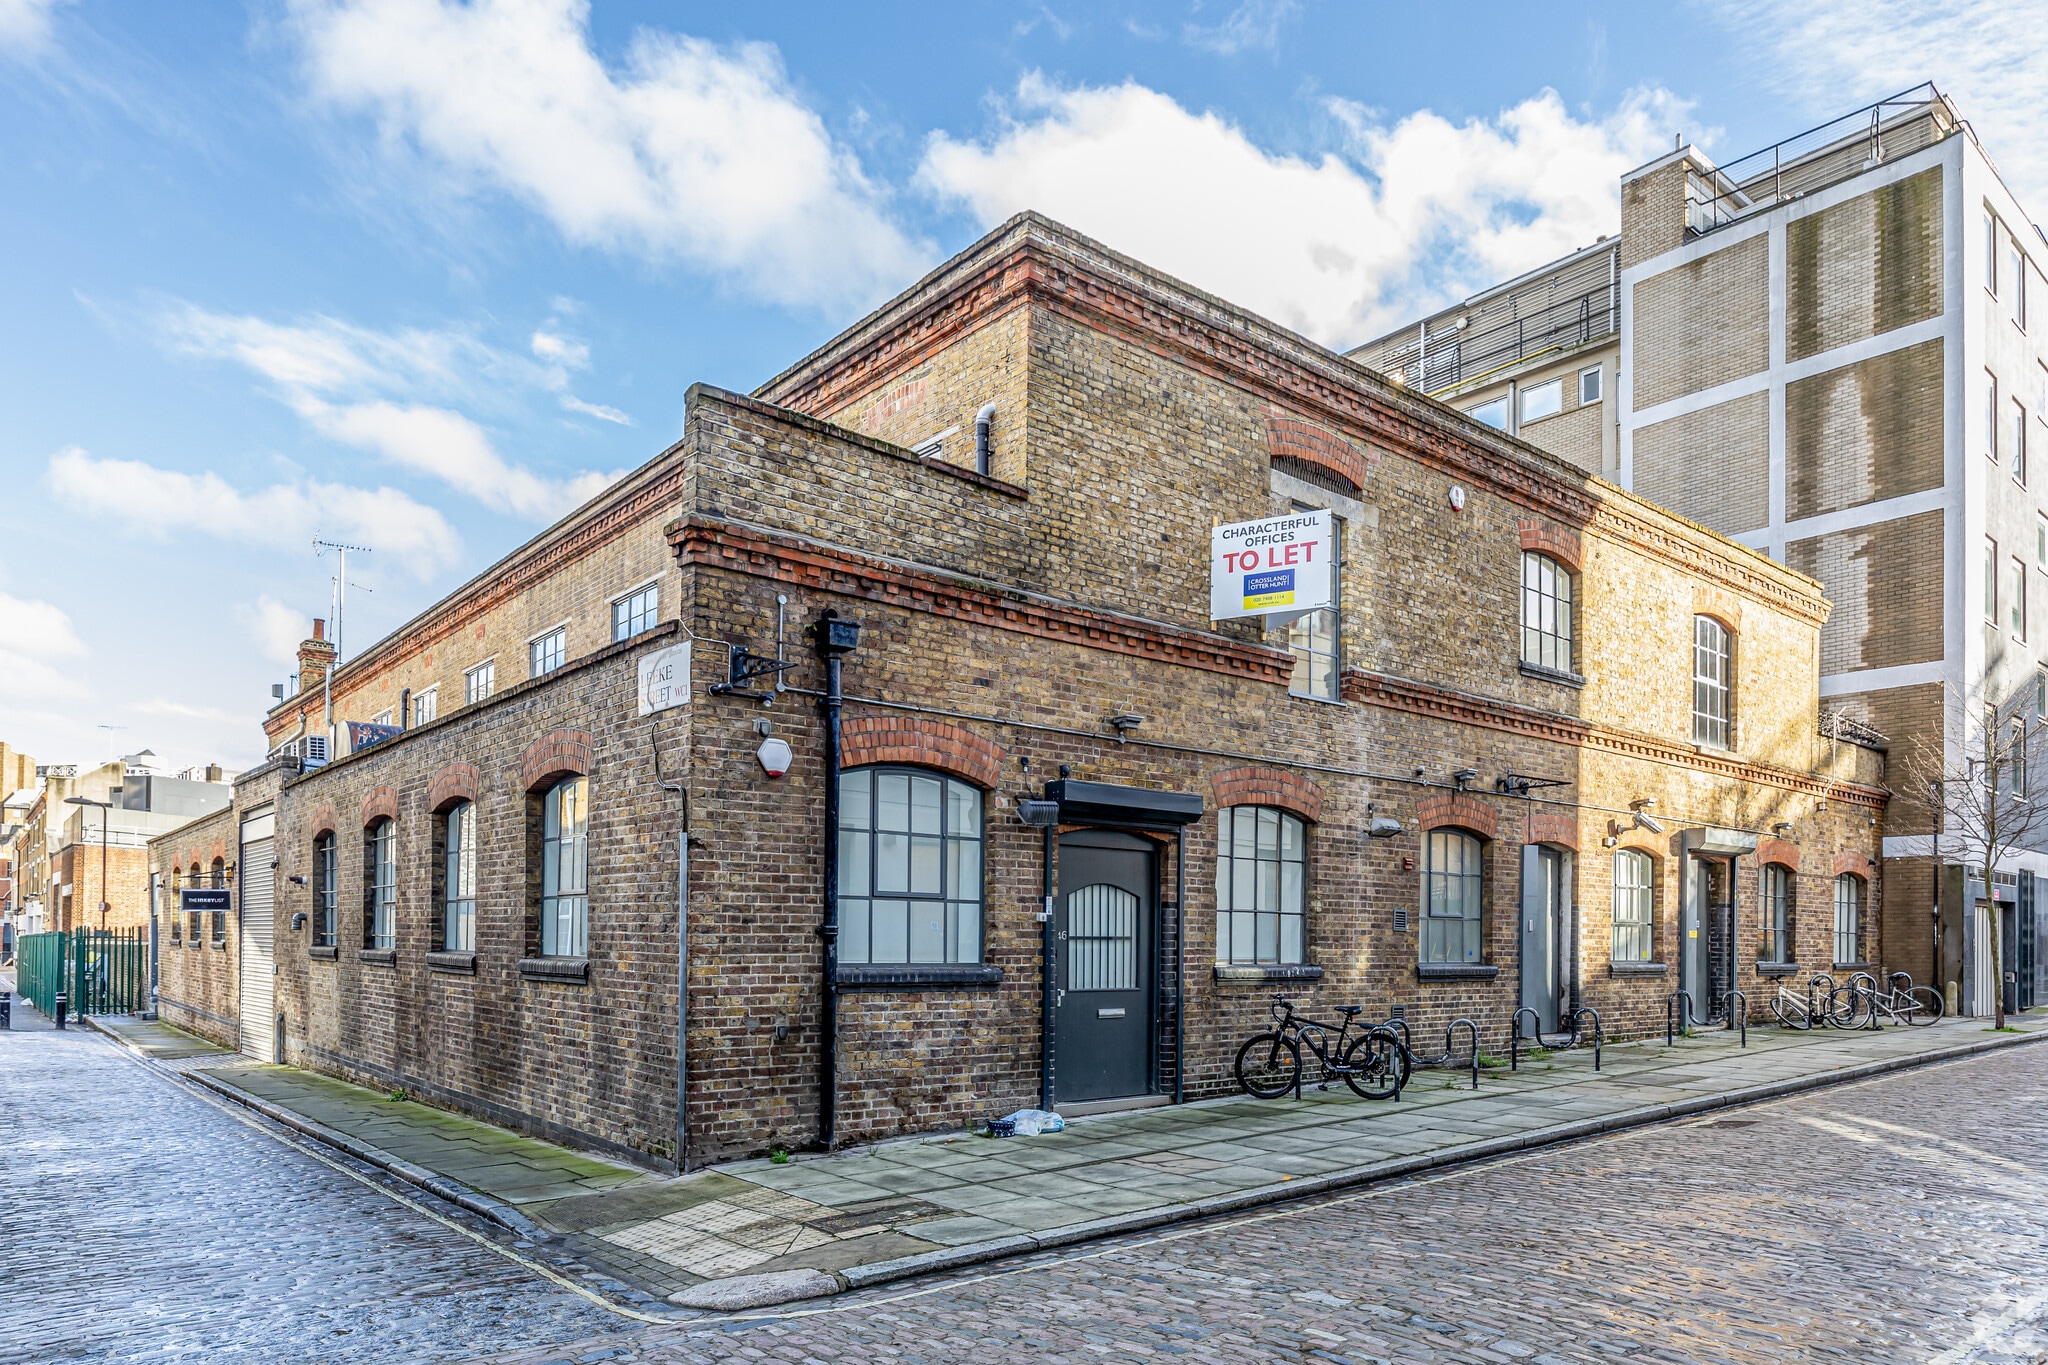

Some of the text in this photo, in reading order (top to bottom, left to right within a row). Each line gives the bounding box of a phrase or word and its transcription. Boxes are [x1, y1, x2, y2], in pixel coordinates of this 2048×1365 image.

[1222, 516, 1319, 539] CHARACTERFUL
[1244, 531, 1294, 547] OFFICES
[1222, 540, 1319, 573] TO LET
[1250, 574, 1288, 585] CROSSLAND
[1250, 580, 1287, 591] OTTER HUNT
[640, 664, 673, 689] LEEKE
[640, 685, 672, 708] STREET
